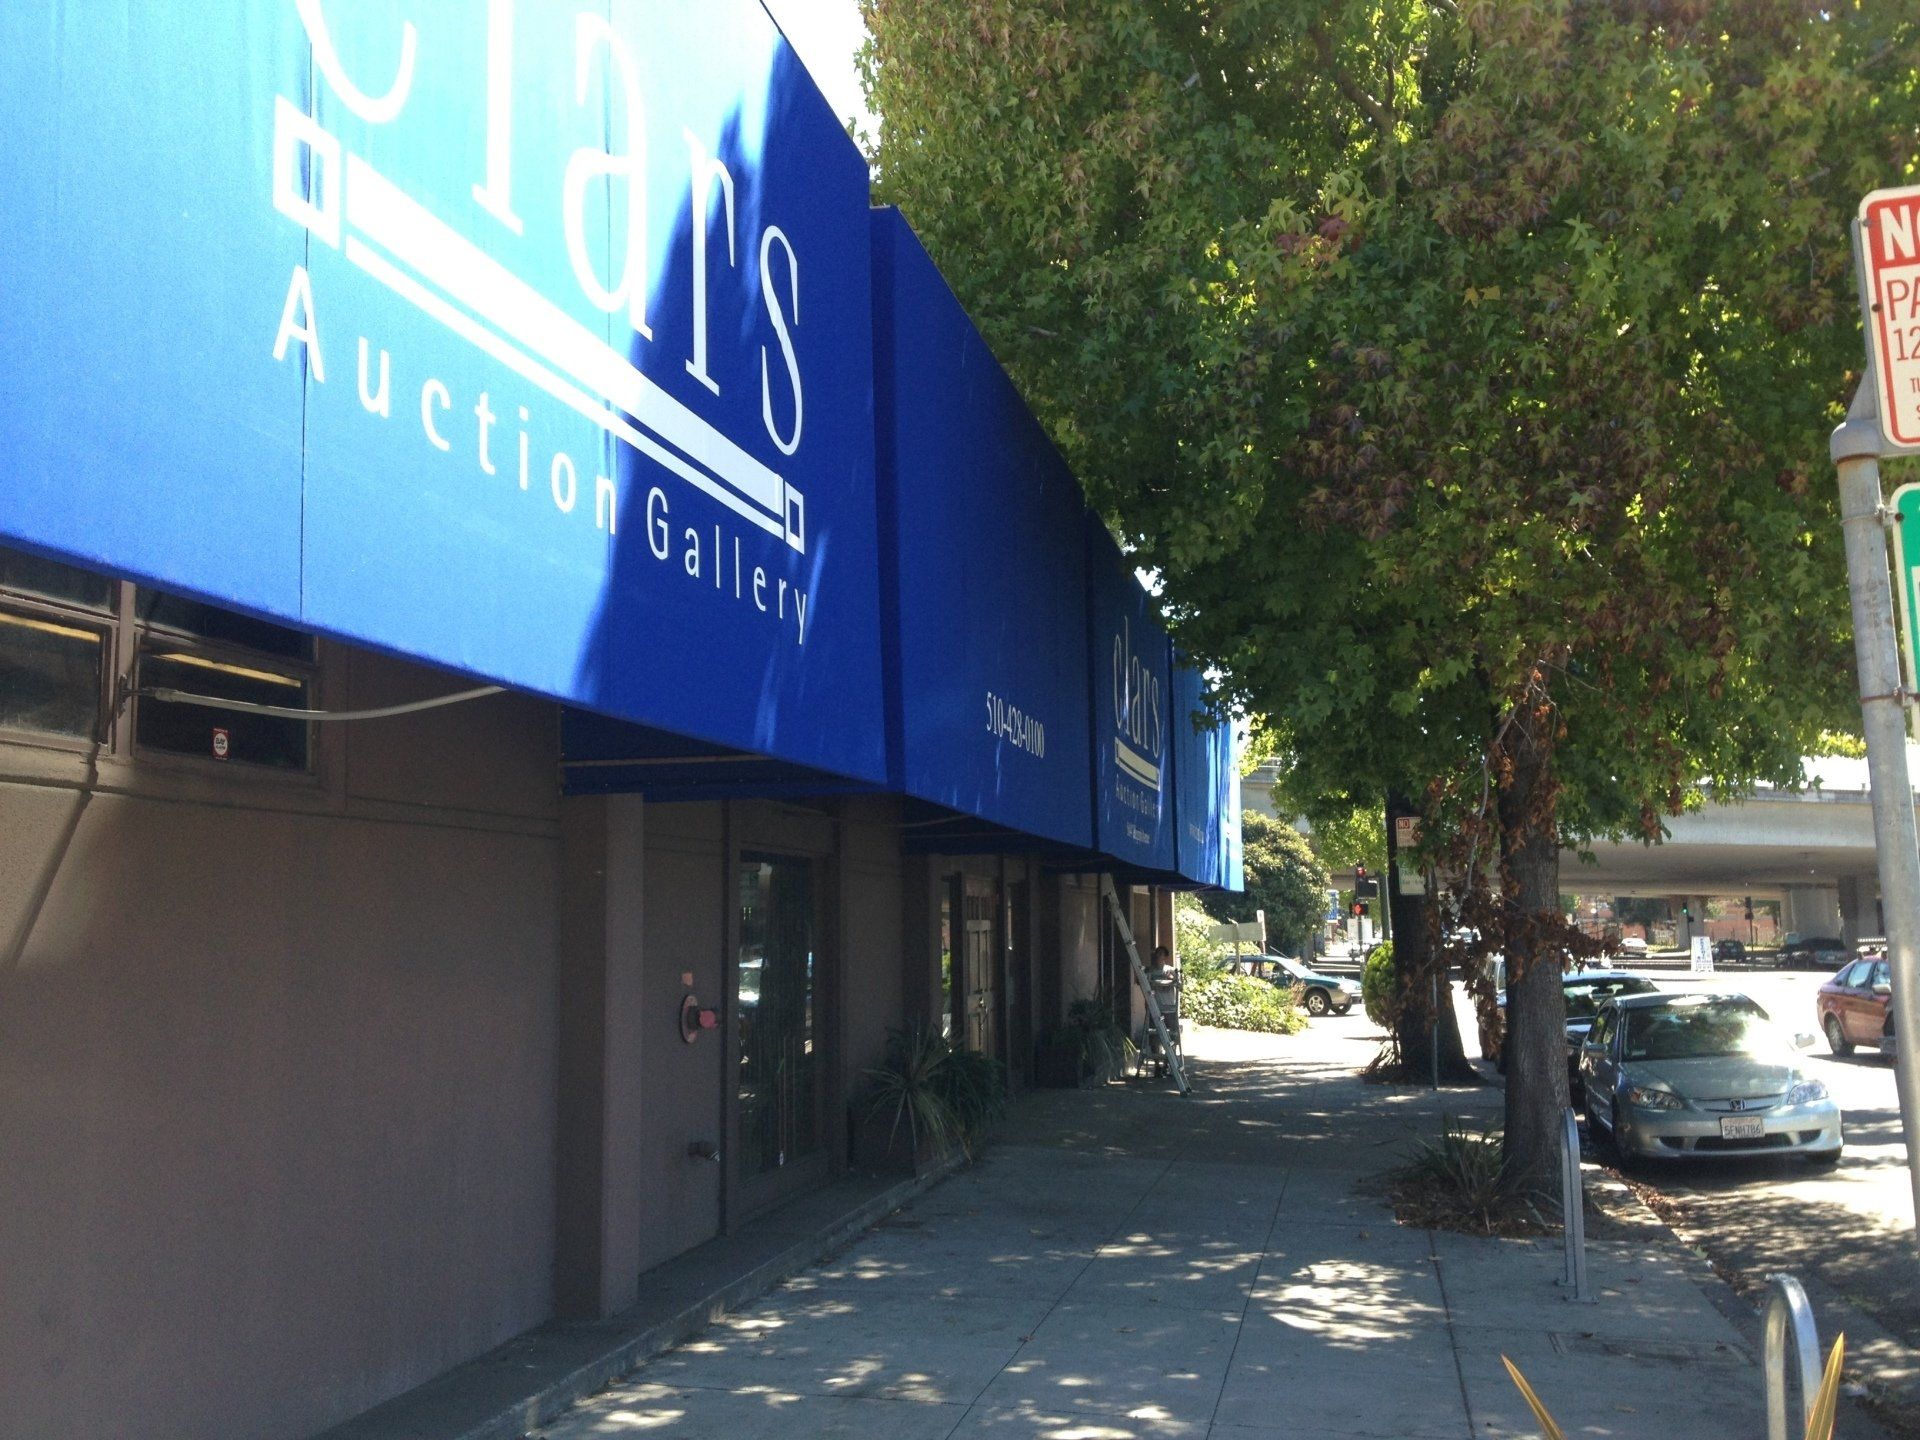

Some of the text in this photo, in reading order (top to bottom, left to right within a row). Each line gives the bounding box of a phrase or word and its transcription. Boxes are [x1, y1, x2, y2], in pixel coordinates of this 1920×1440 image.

[1880, 203, 1920, 261] N
[272, 265, 807, 645] Auction Gallery
[986, 691, 1045, 759] 510-428-0100
